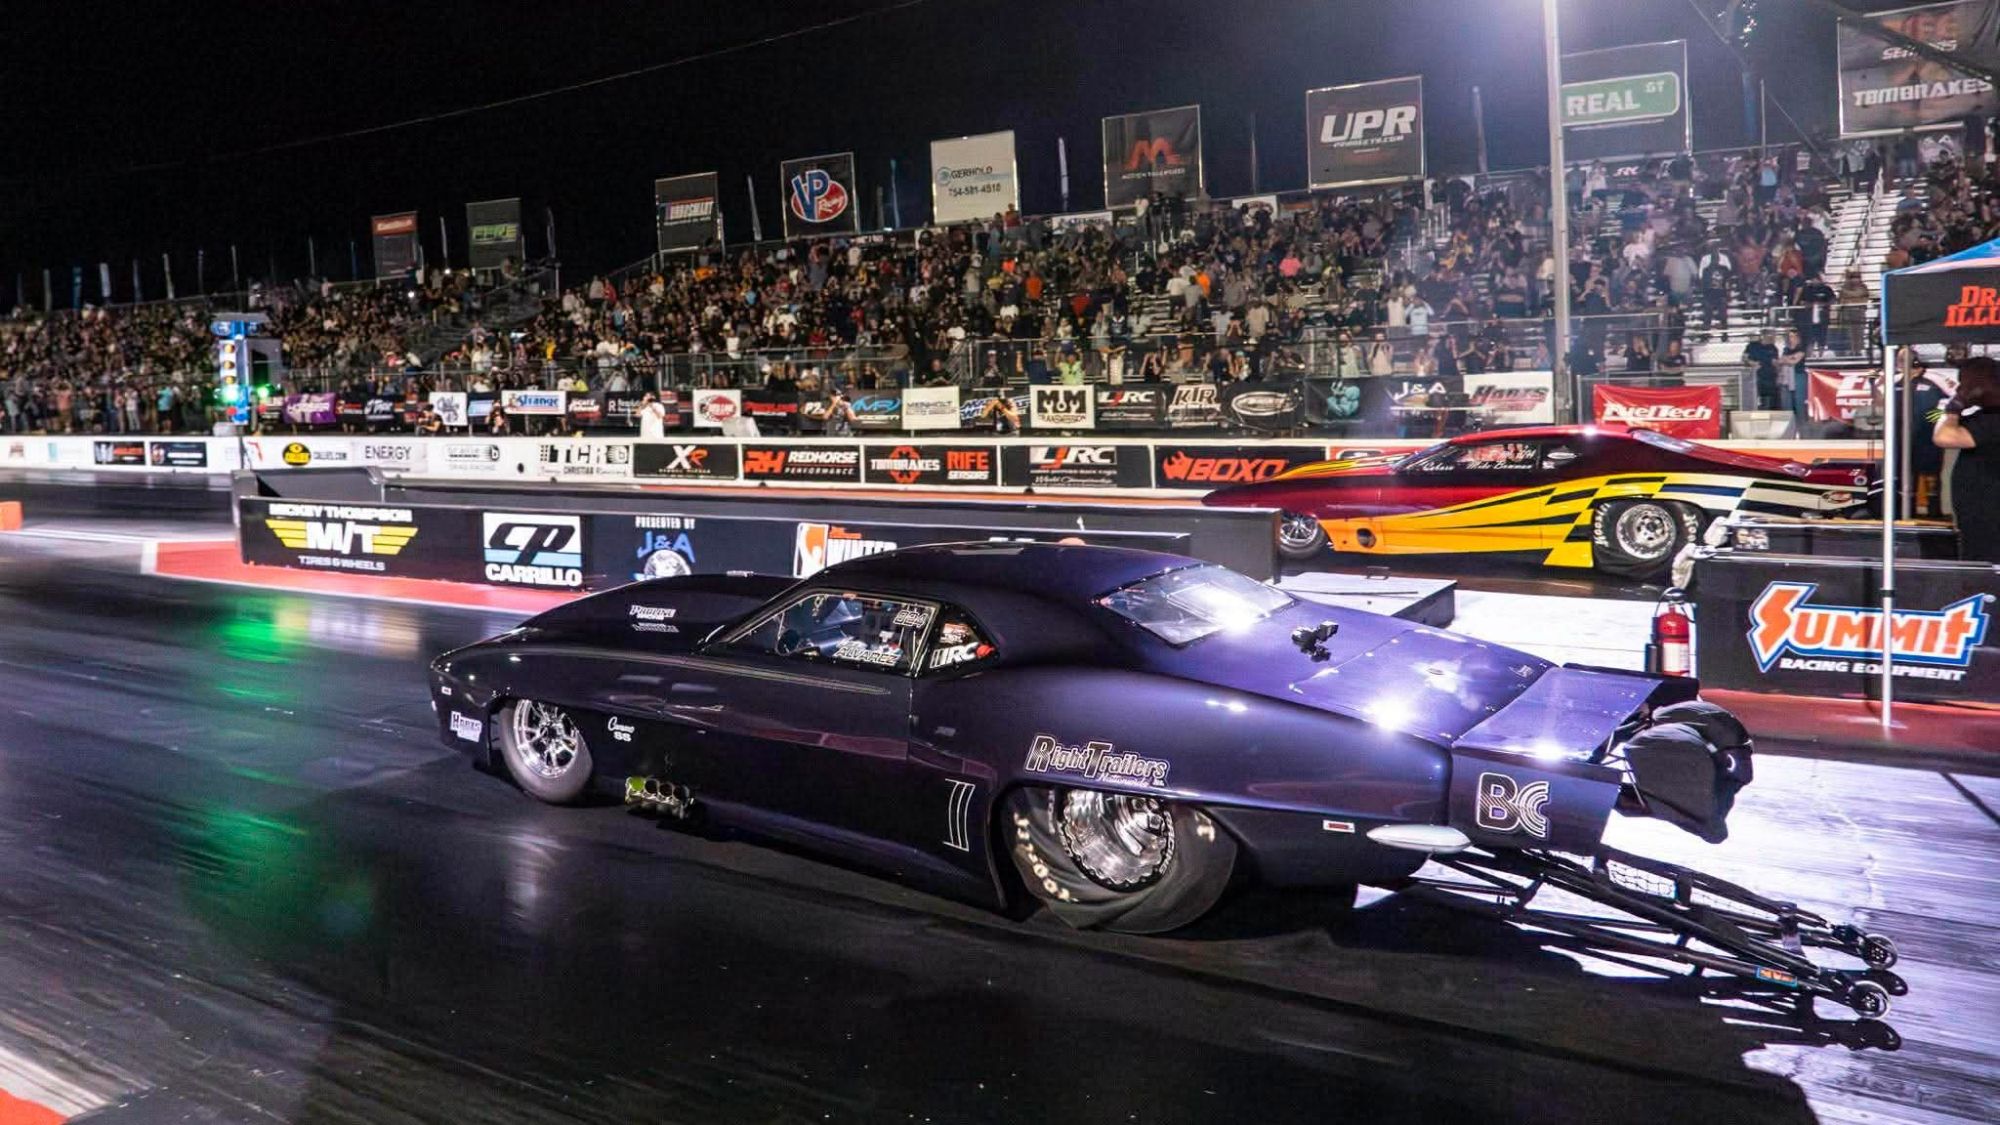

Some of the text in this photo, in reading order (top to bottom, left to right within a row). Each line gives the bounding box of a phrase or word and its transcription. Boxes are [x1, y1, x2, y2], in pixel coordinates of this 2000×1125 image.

[1567, 90, 1641, 116] REAL
[1320, 105, 1416, 143] UPR
[1960, 286, 2000, 307] DR
[365, 446, 412, 461] ENERGY
[788, 451, 859, 464] REDHORSE
[946, 452, 989, 470] RIFE
[784, 467, 855, 476] PERFORMANCE
[268, 503, 413, 522] MICKEY THOMPSON
[635, 515, 696, 530] PRESENTED BY
[636, 530, 697, 564] J&A
[298, 555, 331, 566] TIRES
[341, 558, 386, 571] WHEELS
[484, 564, 583, 586] CARRILLO
[832, 645, 901, 667] ALVAREZ
[1779, 657, 1968, 681] RACING EQIPMENT
[1473, 772, 1550, 839] BC
